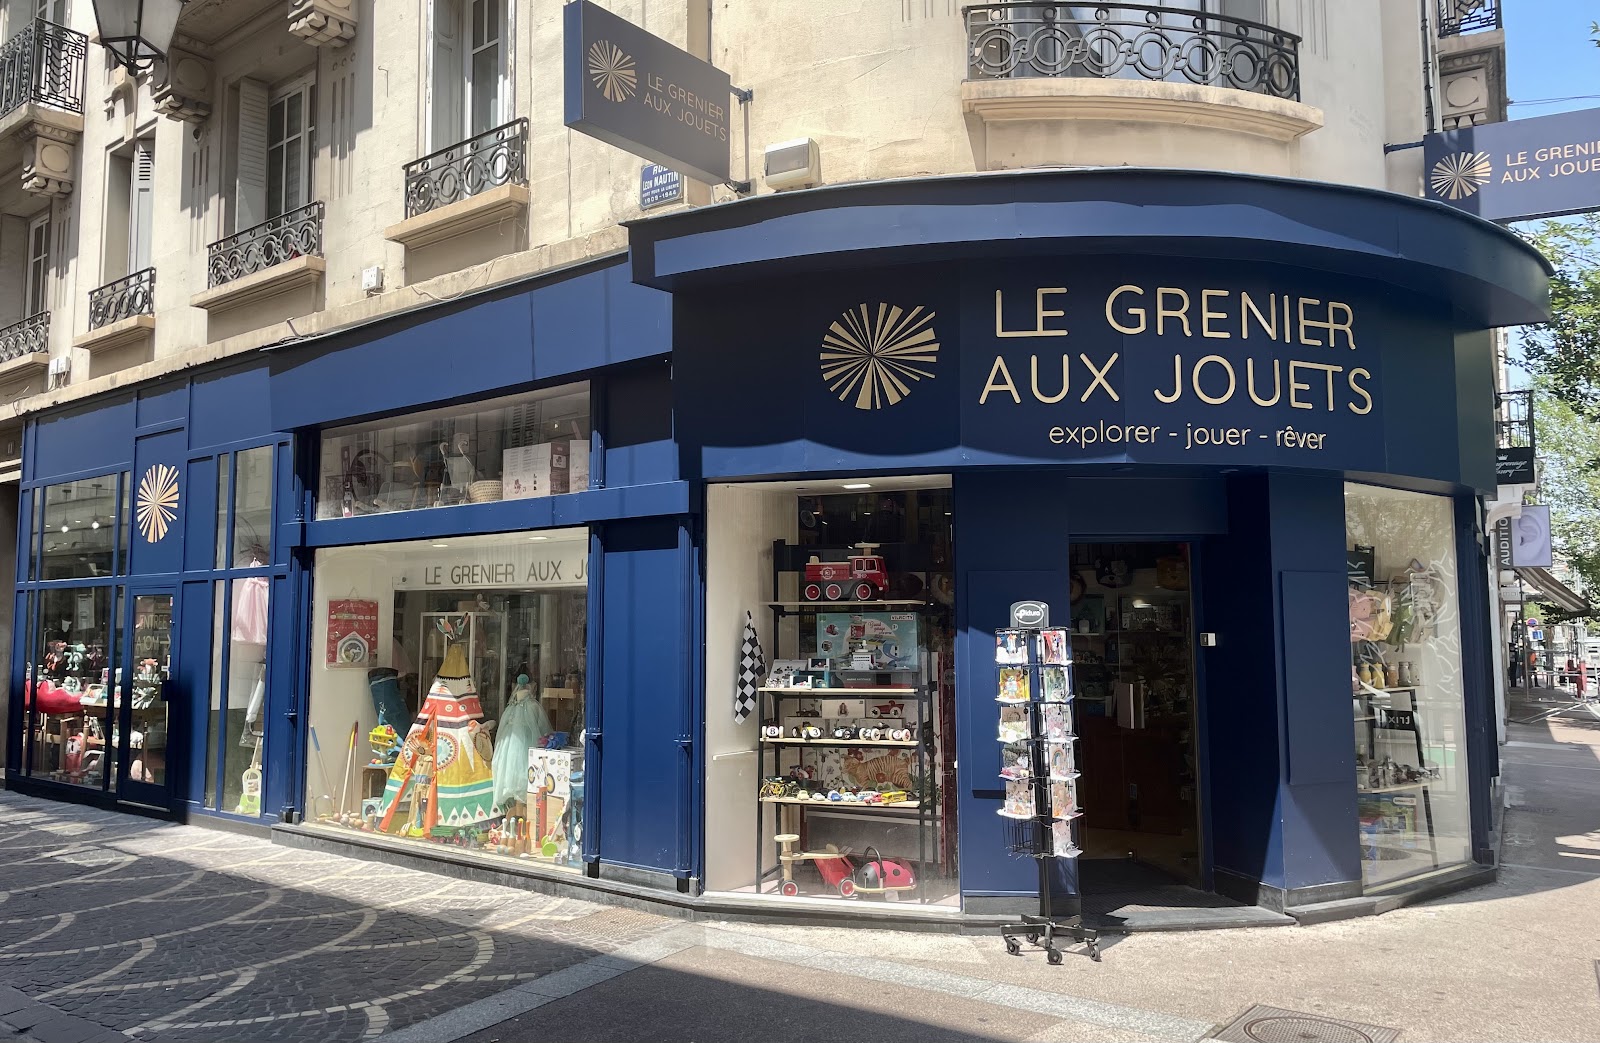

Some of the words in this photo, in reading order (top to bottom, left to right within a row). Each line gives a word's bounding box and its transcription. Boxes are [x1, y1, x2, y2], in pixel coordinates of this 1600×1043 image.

[648, 73, 663, 92] LE
[668, 84, 724, 121] GRENIER
[644, 93, 671, 116] AUX
[677, 108, 726, 141] JOUETS
[1506, 152, 1528, 167] LE
[1535, 141, 1600, 162] GRENI
[654, 171, 679, 187] NAUTIN
[1501, 167, 1540, 184] AUX
[995, 287, 1068, 338] LE
[1105, 284, 1356, 350] GRENIER
[979, 352, 1120, 405] AUX
[1154, 354, 1373, 415] JOUETS
[1049, 419, 1160, 449] explorer
[1185, 423, 1250, 450] jouer
[1275, 425, 1327, 450] rêver
[425, 567, 441, 584] LE
[451, 563, 515, 584] GRENIER
[527, 560, 562, 581] AUX
[575, 559, 588, 580] J
